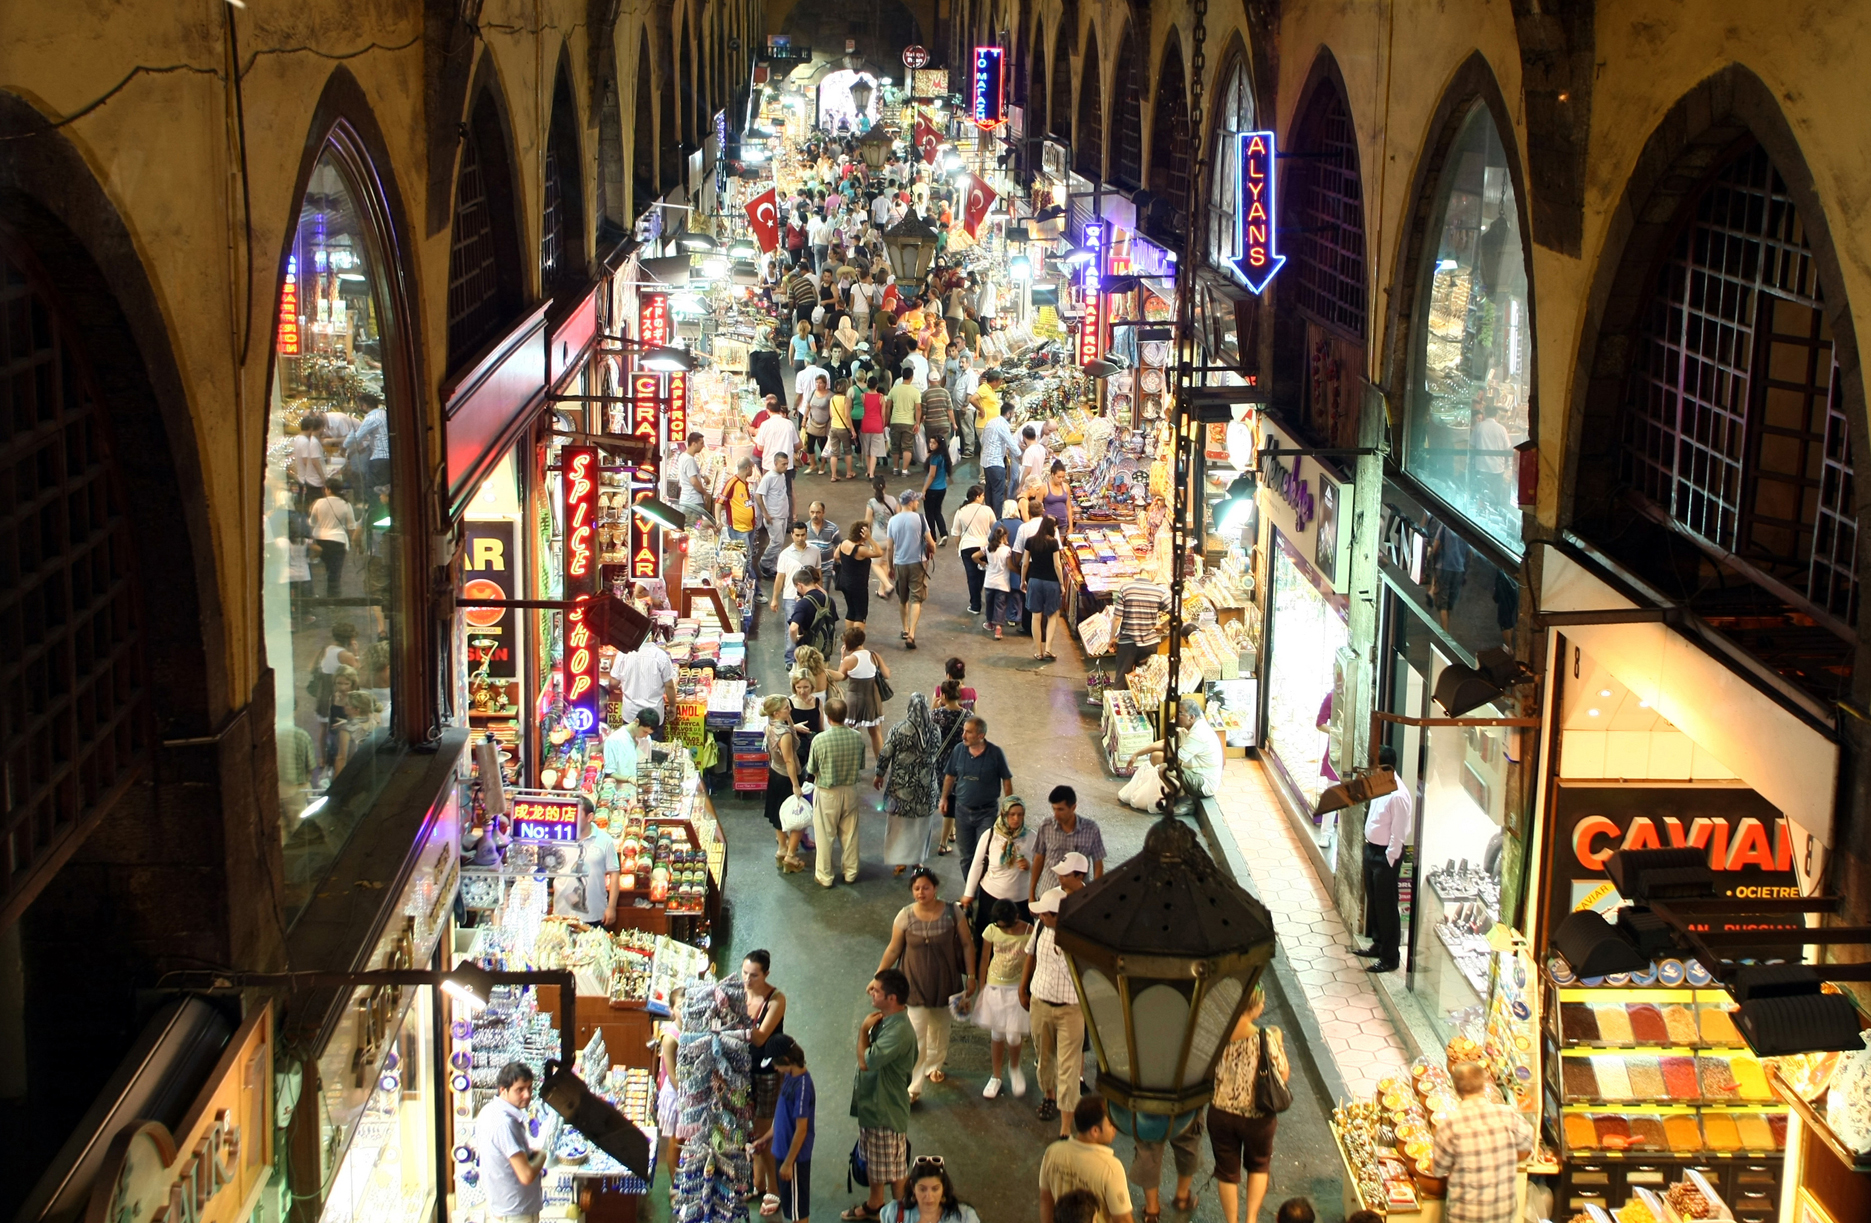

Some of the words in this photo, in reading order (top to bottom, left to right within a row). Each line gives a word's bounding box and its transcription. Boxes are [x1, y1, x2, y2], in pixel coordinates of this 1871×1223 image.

[1247, 136, 1266, 266] ALYANS
[569, 453, 592, 576] SPICE
[554, 824, 572, 840] 11
